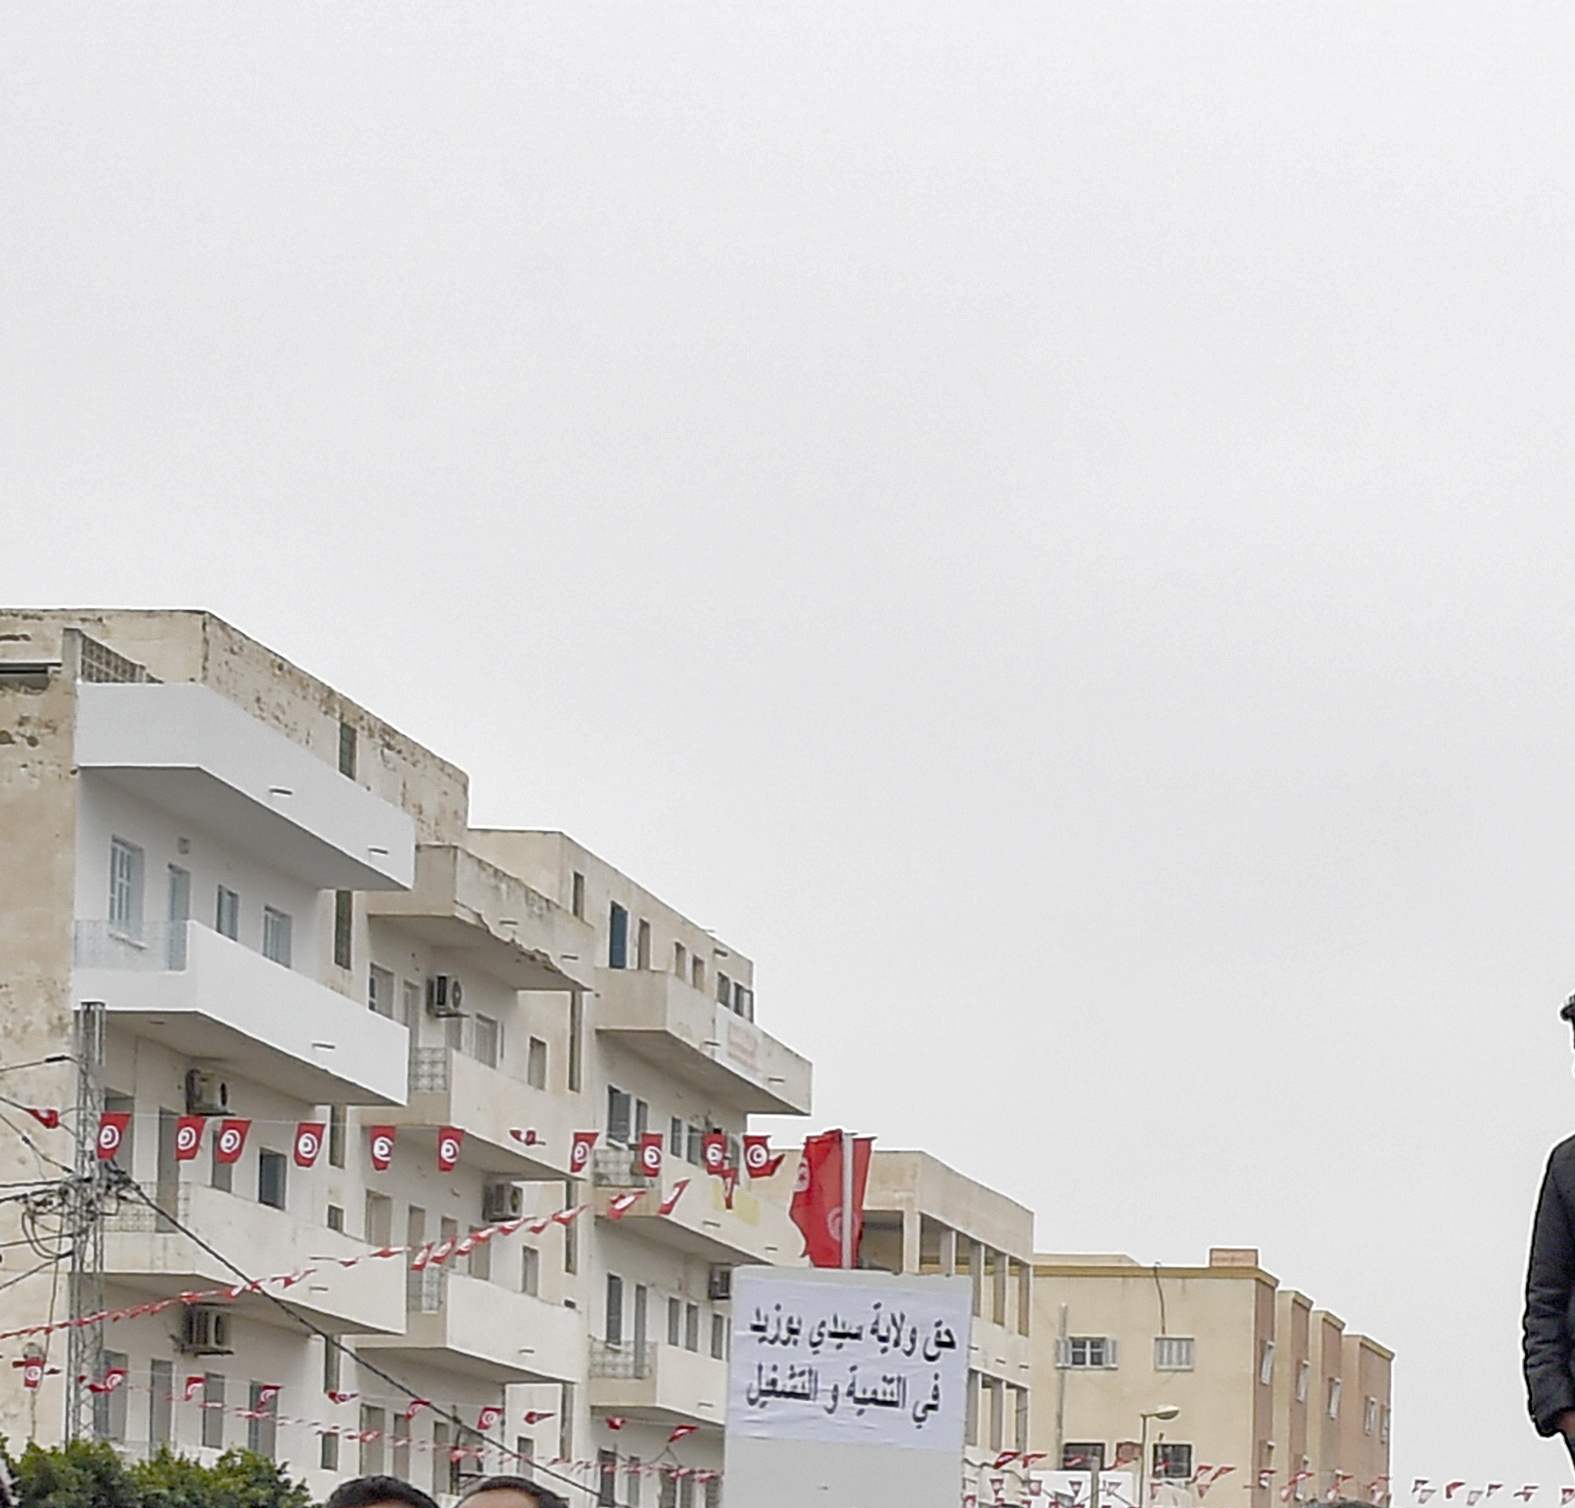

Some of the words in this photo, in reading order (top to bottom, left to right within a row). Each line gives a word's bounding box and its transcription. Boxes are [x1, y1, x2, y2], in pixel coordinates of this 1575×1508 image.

[750, 1304, 801, 1347] بوزيد
[809, 1313, 862, 1355] سيدي
[870, 1303, 916, 1357] ولاية
[923, 1319, 956, 1362] حق
[746, 1364, 818, 1409] التشغيل
[846, 1365, 906, 1417] التنمية
[912, 1372, 940, 1428] في
